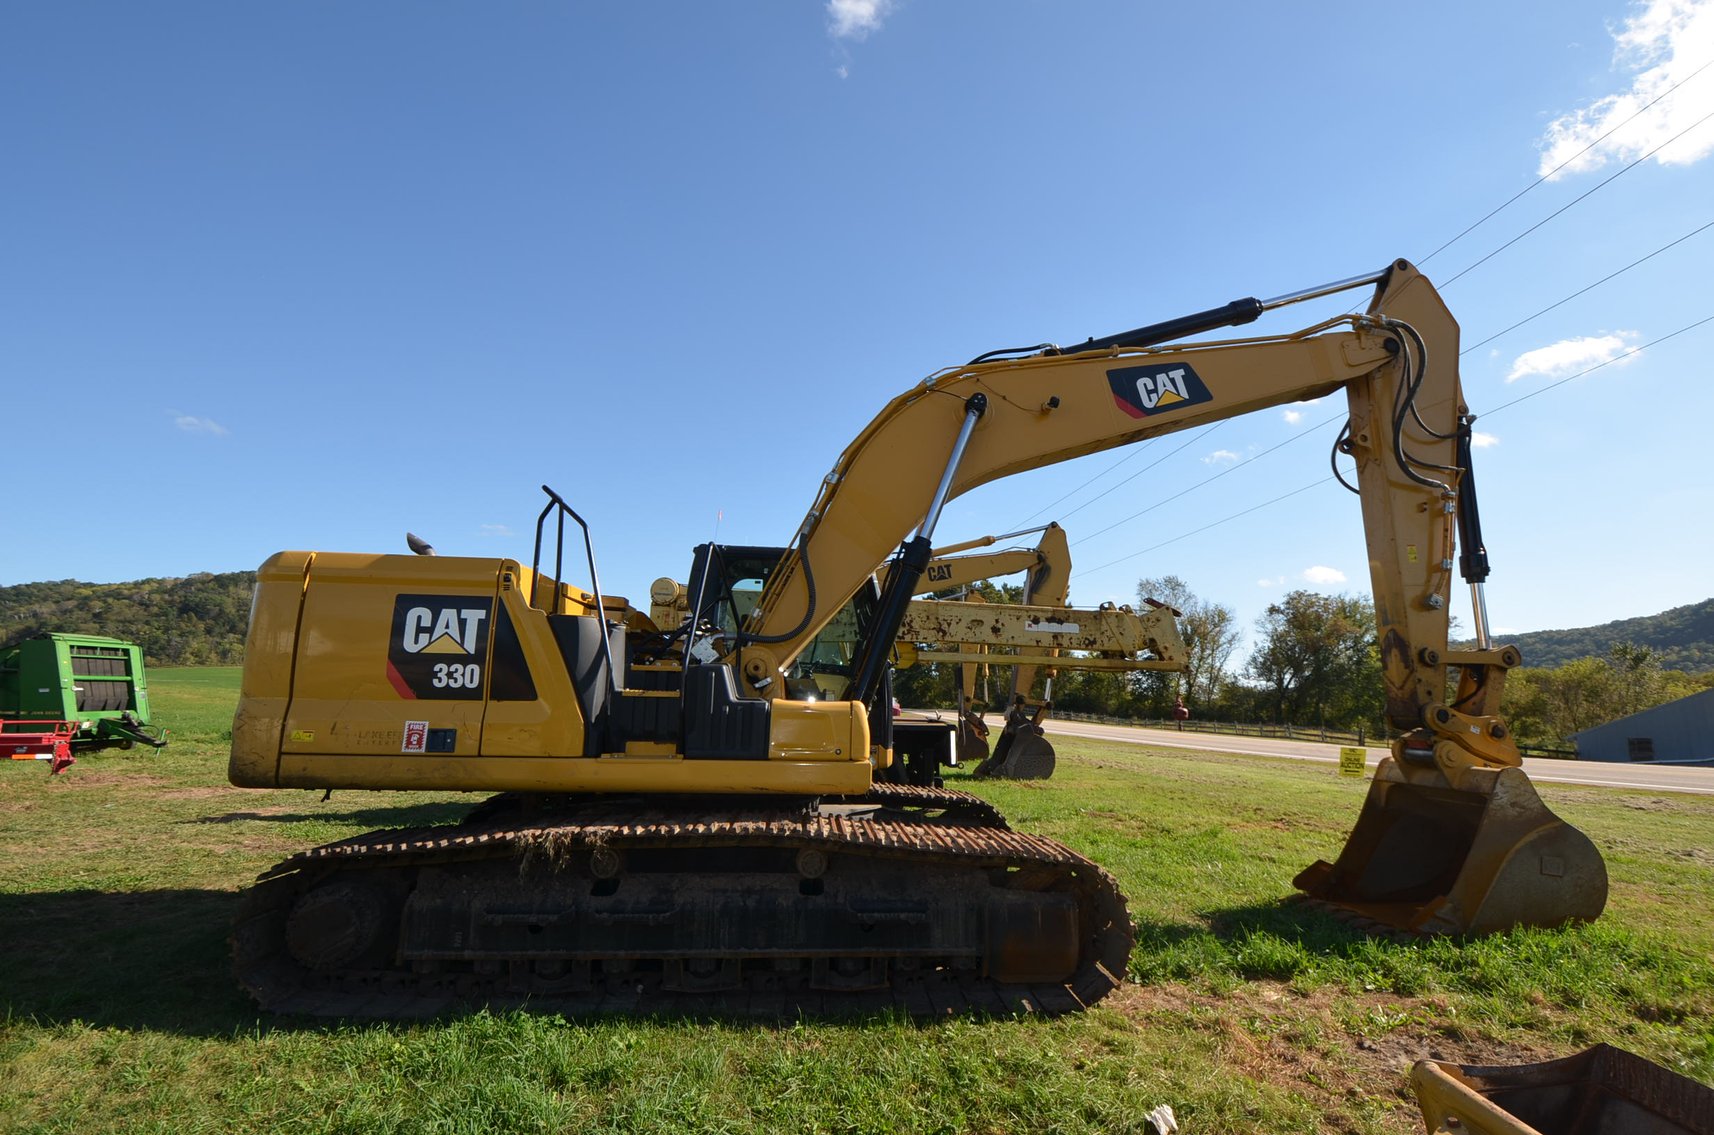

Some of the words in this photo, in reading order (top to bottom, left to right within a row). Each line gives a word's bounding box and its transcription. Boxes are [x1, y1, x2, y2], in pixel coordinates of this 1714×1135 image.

[1136, 369, 1189, 409] CAT
[928, 564, 952, 581] CAT
[403, 607, 486, 654] CAT
[432, 663, 480, 688] 330
[1340, 761, 1365, 769] AUCTION
